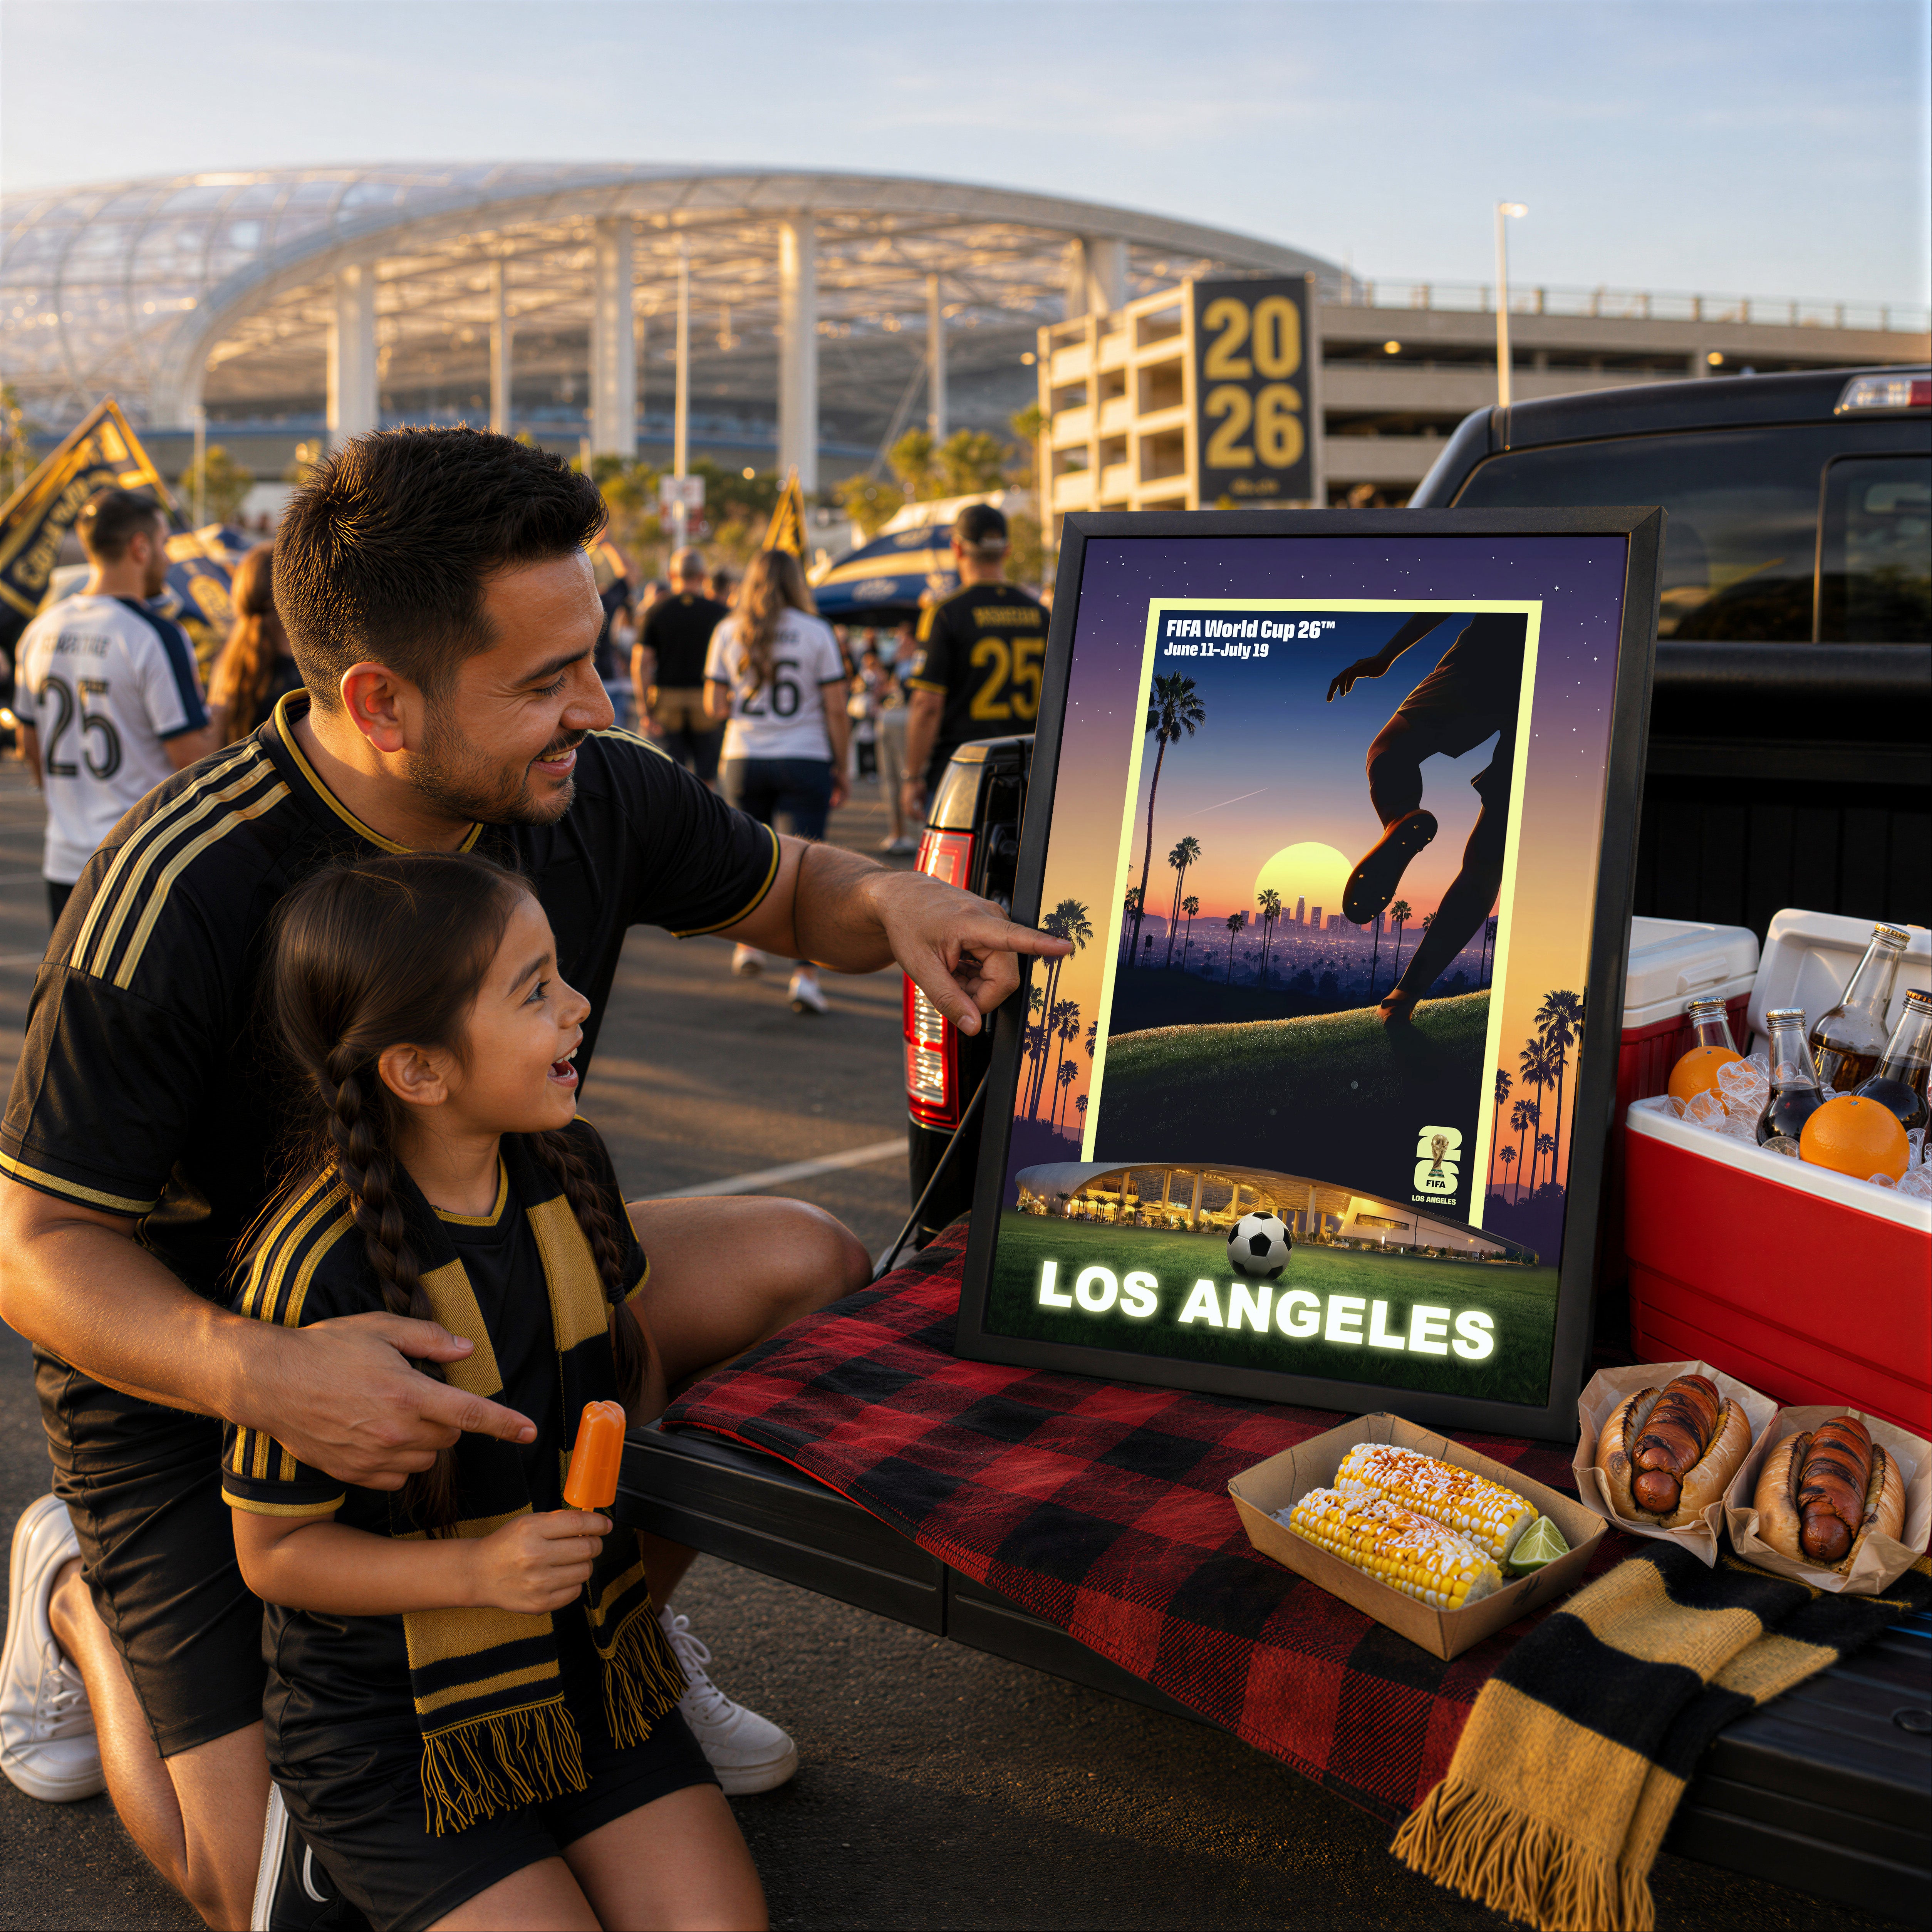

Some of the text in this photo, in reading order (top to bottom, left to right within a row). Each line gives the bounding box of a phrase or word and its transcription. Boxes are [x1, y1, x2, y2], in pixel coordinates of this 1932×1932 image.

[1202, 297, 1301, 380] 20
[1204, 384, 1303, 468] 26
[1164, 642, 1198, 656] June
[1252, 643, 1269, 657] 19
[1166, 619, 1201, 637] FIFA
[1205, 619, 1259, 638] World
[1261, 620, 1295, 642] Cup
[969, 636, 1046, 721] 25
[38, 676, 121, 778] 25
[1426, 1179, 1446, 1188] FIFA
[1426, 1196, 1456, 1205] ANGELES
[1038, 1260, 1494, 1360] LOS ANGELES
